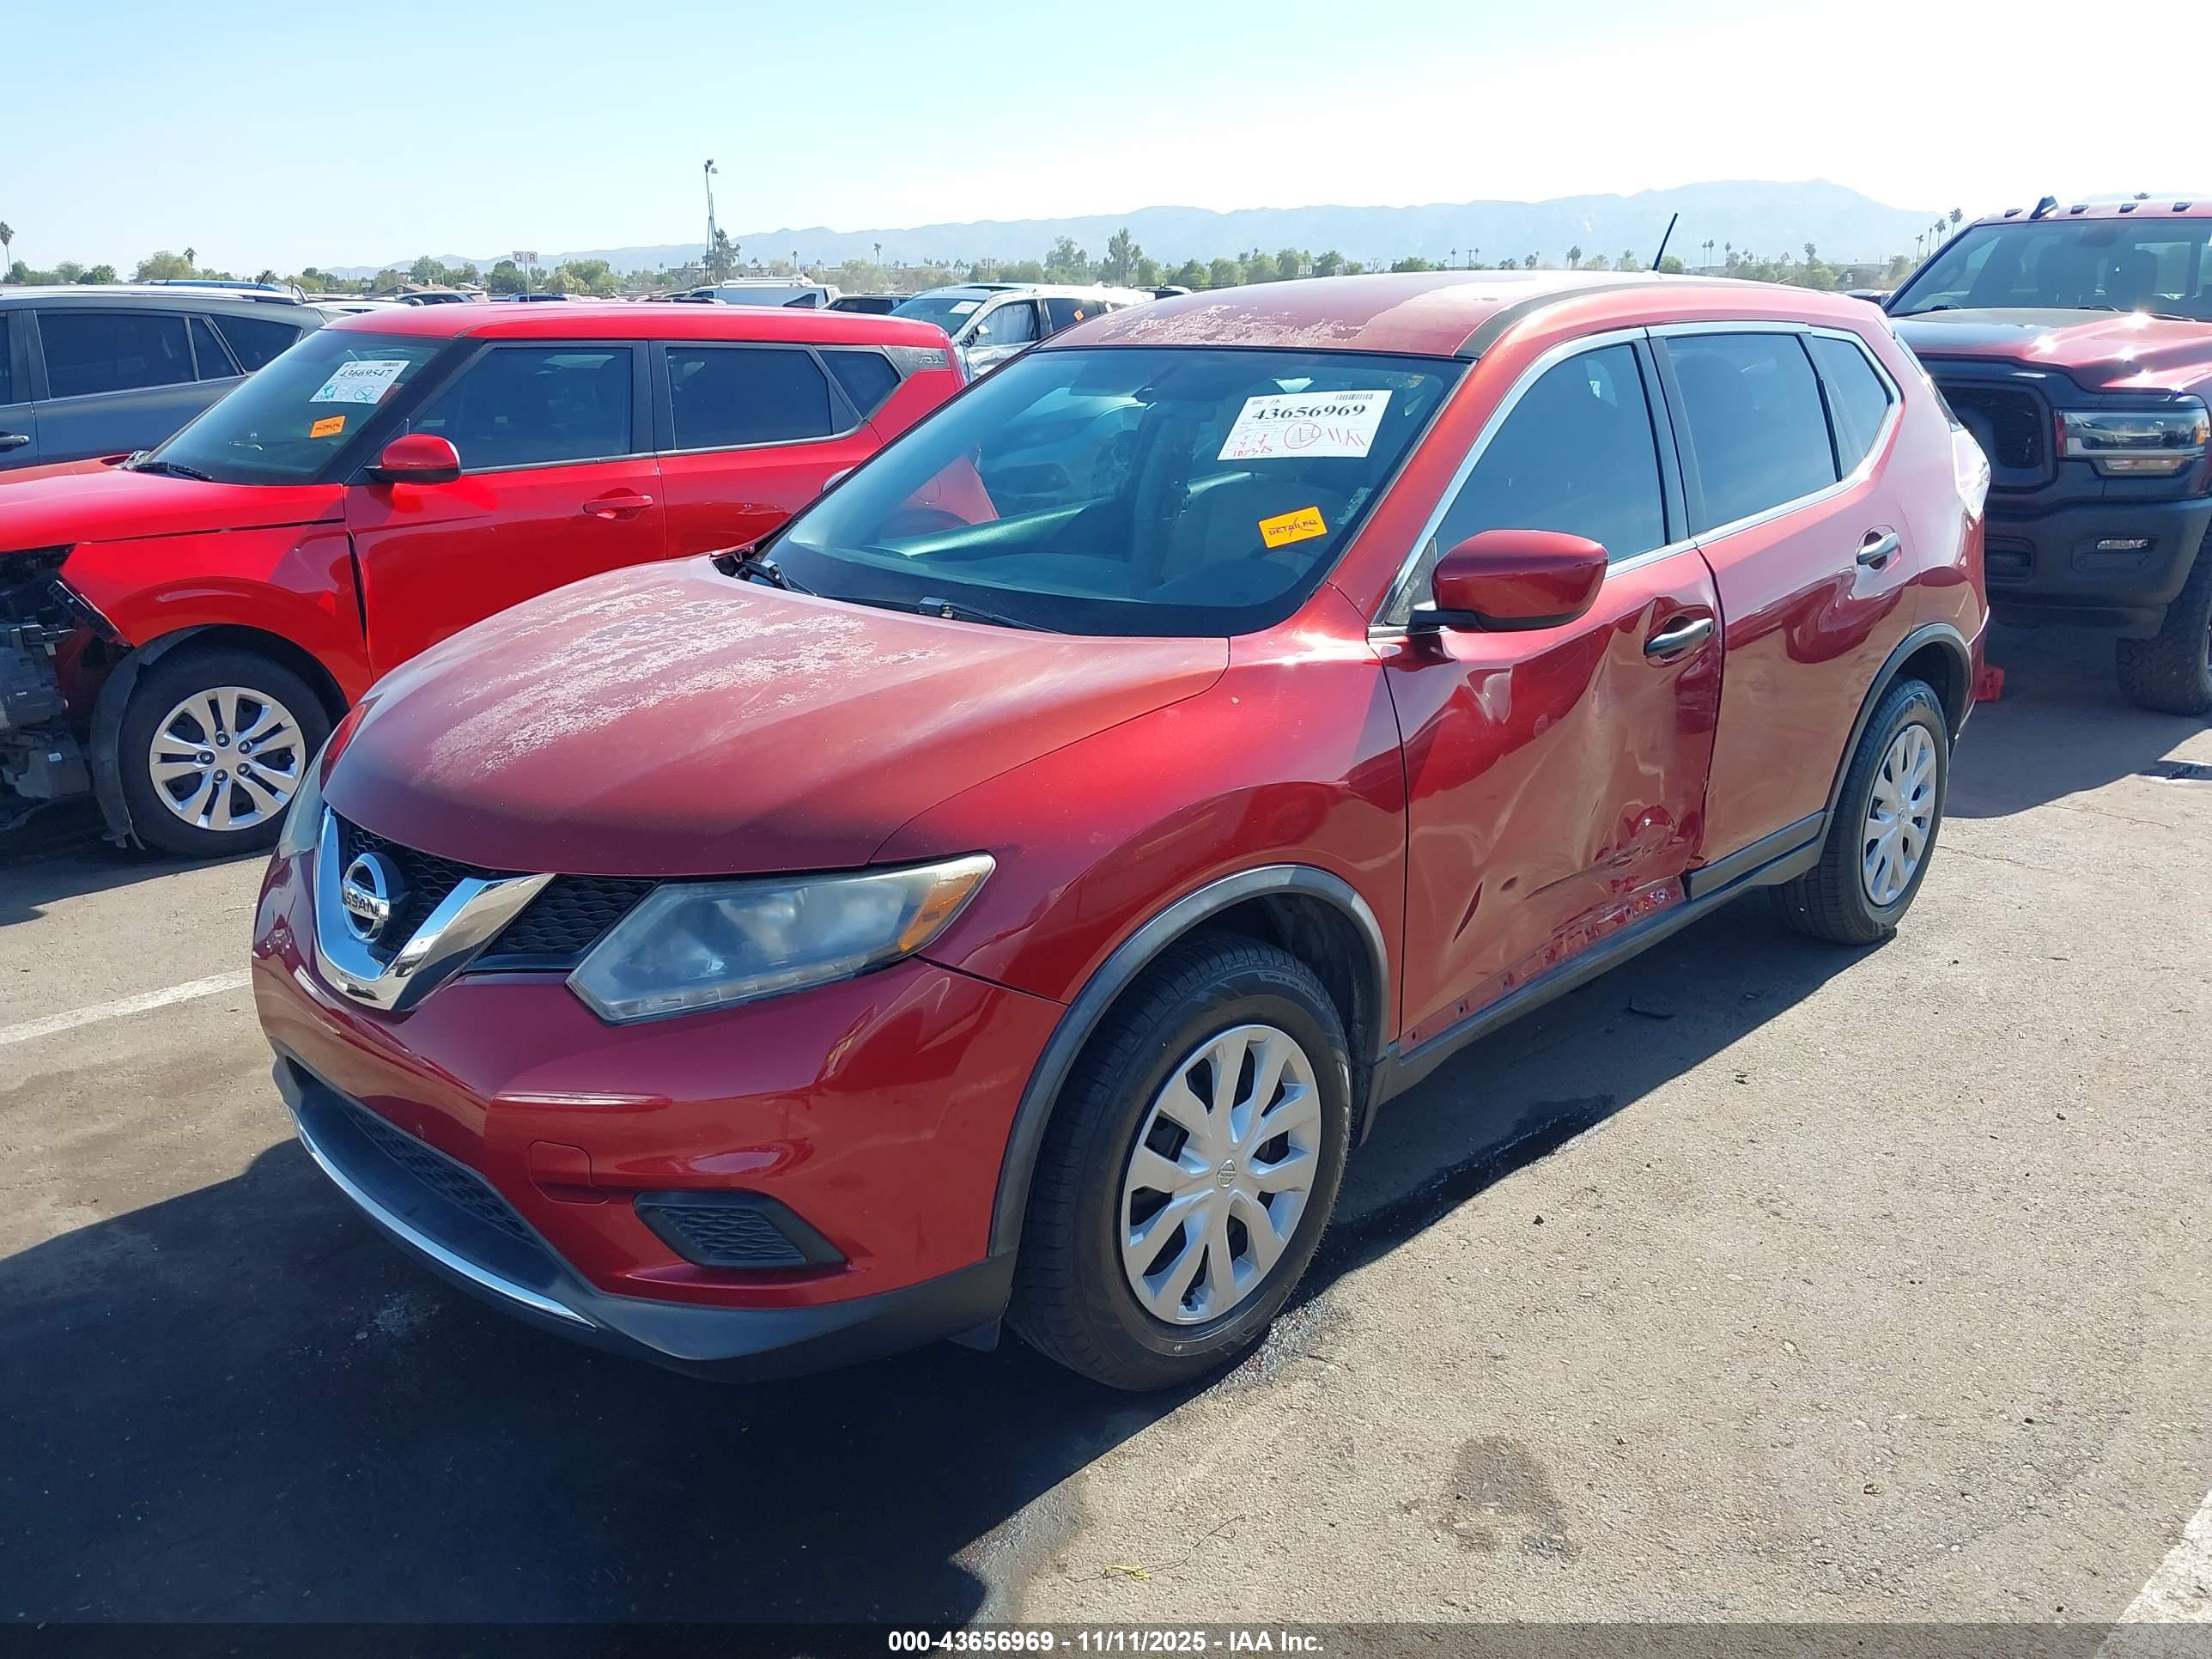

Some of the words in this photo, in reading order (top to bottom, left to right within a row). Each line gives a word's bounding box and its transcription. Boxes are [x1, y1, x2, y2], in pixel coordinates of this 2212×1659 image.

[529, 253, 536, 262] R
[338, 369, 394, 378] 43669547
[1252, 404, 1366, 420] 43656969
[343, 889, 380, 916] ISSAN
